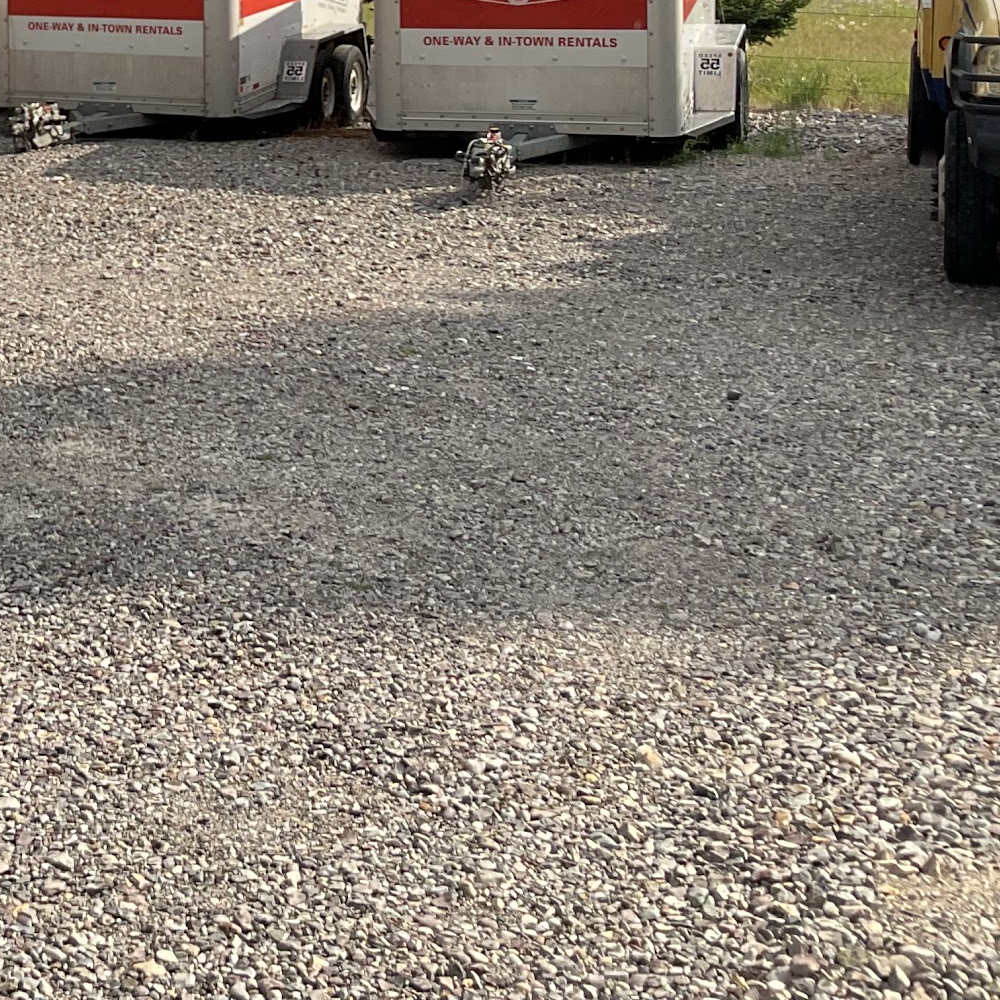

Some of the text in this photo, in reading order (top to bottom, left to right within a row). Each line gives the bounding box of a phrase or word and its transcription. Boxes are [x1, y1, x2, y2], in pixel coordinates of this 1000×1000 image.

[28, 21, 183, 36] ONE-WAY & IN-TOWN RENTALS
[423, 35, 618, 49] ONE-WAY & IN-TOWN RENTALS
